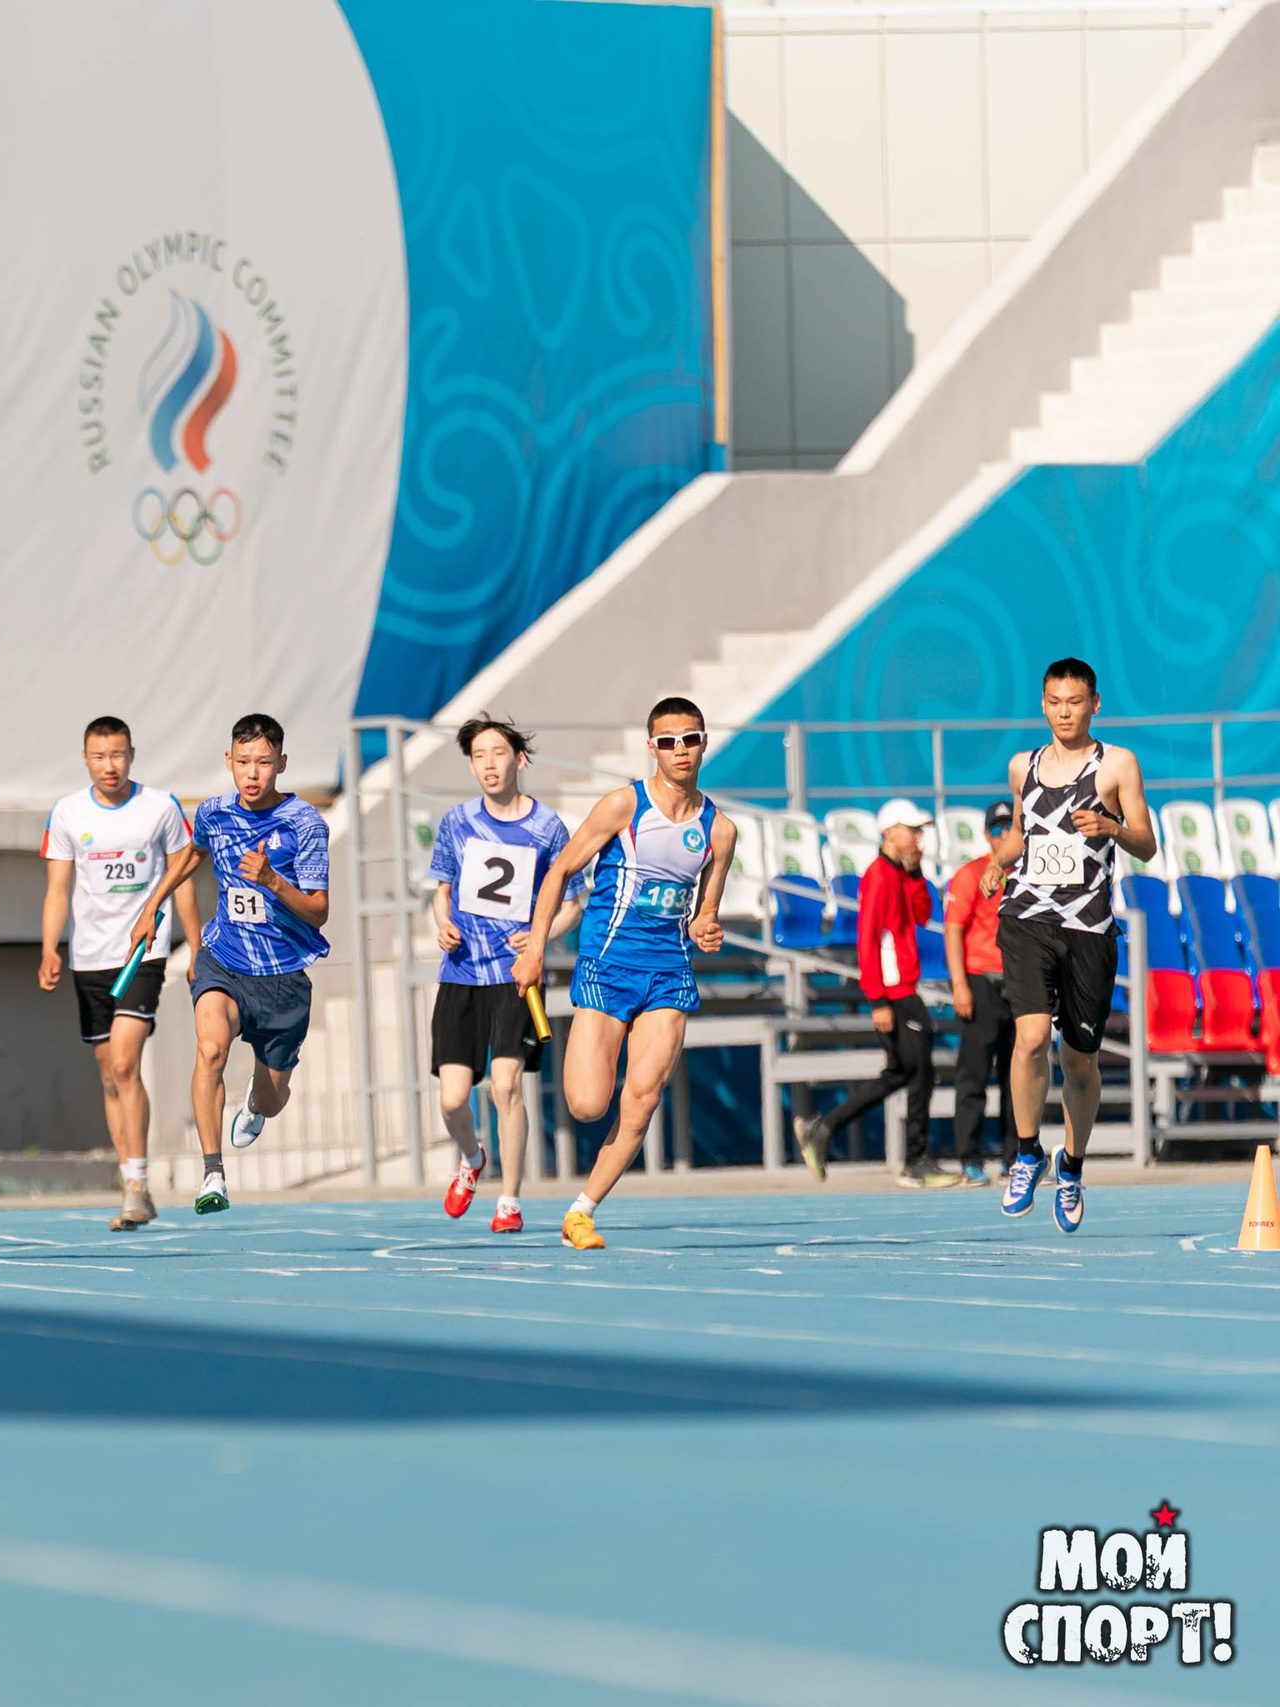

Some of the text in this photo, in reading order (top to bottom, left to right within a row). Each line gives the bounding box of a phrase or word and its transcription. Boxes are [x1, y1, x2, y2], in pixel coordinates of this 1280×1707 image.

[78, 230, 298, 477] RUSSIAN OLYMPIC COMMITTEE
[105, 863, 135, 880] 229
[1033, 843, 1076, 876] 585
[477, 857, 515, 905] 2
[234, 895, 257, 915] 51
[648, 885, 688, 909] 183
